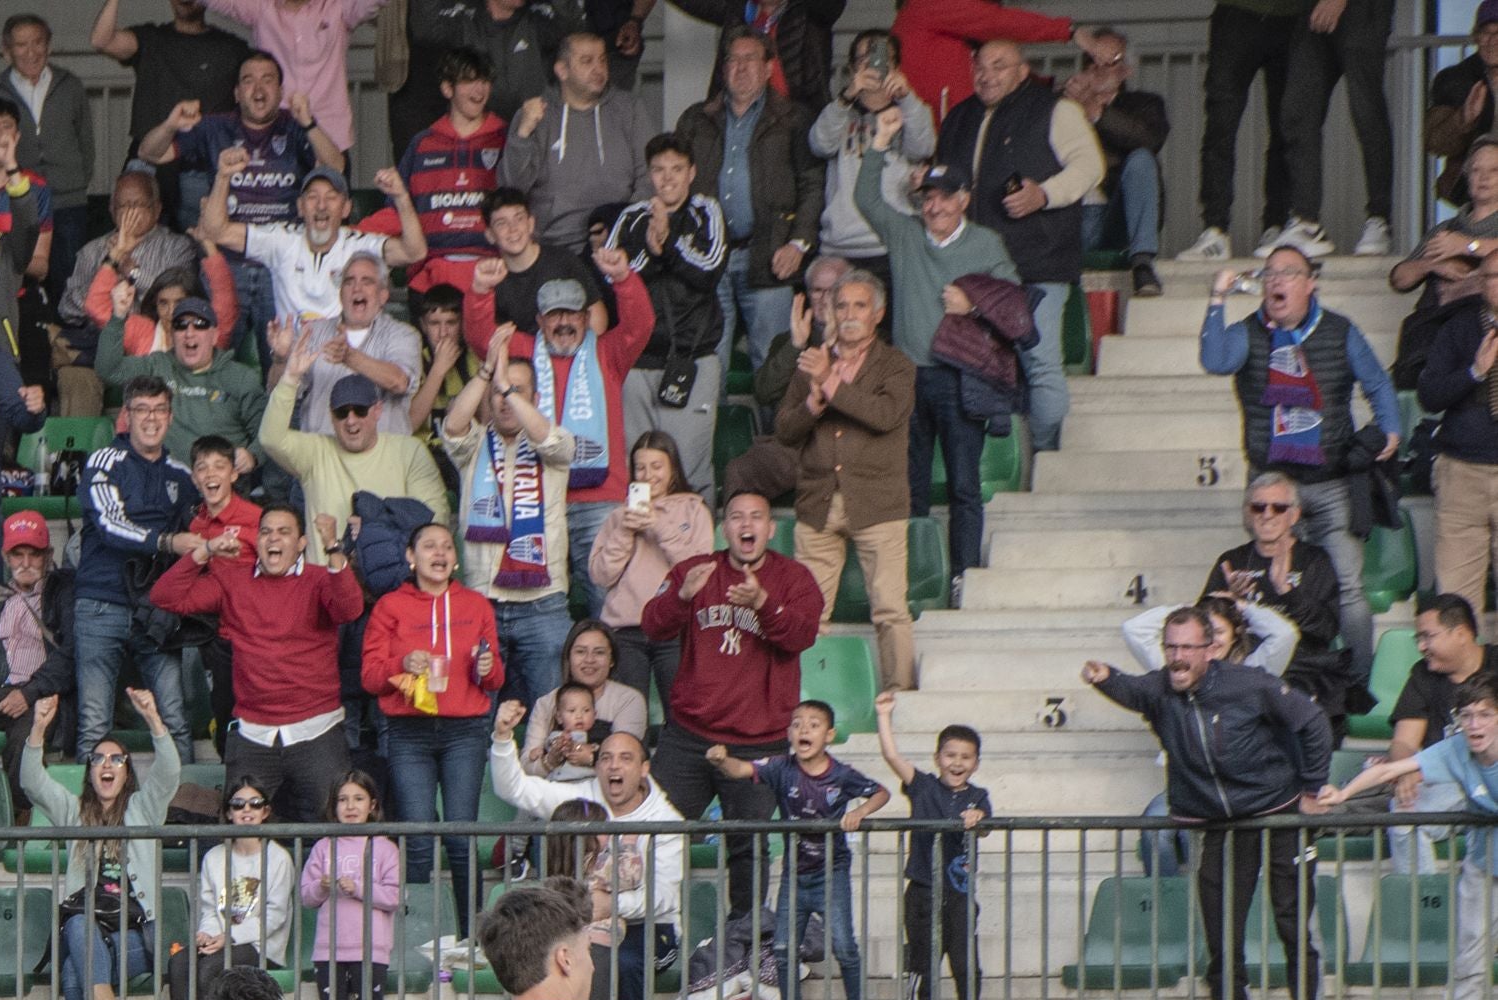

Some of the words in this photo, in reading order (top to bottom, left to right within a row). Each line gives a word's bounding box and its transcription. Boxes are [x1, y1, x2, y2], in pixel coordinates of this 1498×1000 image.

[1125, 574, 1149, 605] 4
[1043, 697, 1067, 727] 3
[4, 908, 13, 921] 6
